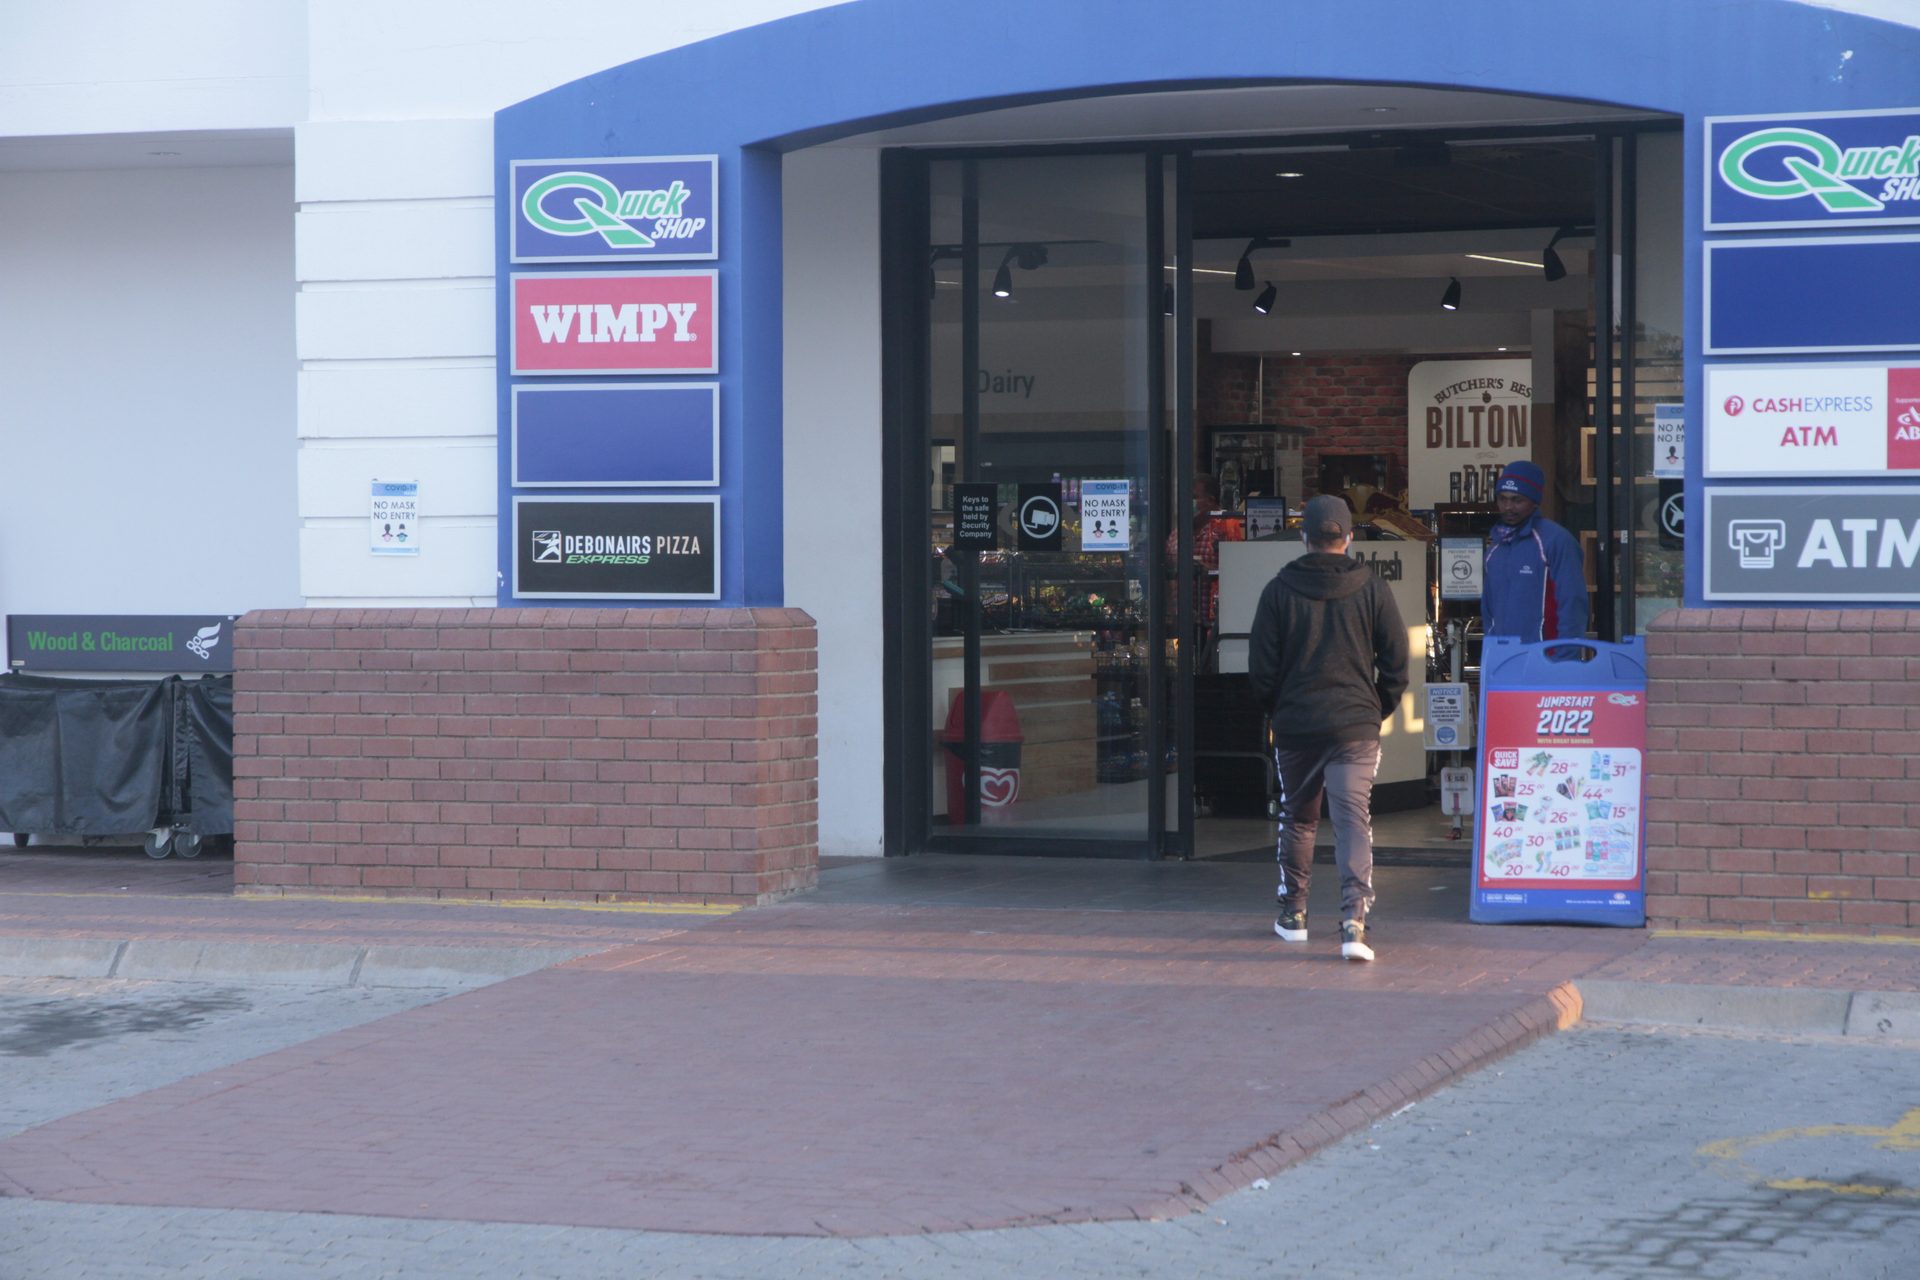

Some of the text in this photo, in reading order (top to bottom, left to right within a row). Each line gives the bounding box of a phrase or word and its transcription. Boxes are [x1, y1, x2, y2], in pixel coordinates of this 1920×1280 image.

[651, 218, 705, 239] SHOP
[530, 303, 696, 343] WIMPY
[977, 370, 1035, 398] Dairy
[1434, 378, 1504, 404] BUTCHER'S
[1752, 397, 1873, 413] CASHEXPRESS
[1426, 405, 1527, 448] BILTON
[1658, 424, 1673, 432] NO
[1657, 434, 1673, 442] NO
[1780, 426, 1838, 446] ATM
[962, 495, 980, 504] Keys
[1085, 499, 1126, 508] NO MASK
[374, 501, 415, 510] NO MASK
[374, 512, 416, 520] NO ENTRY
[963, 512, 989, 521] held by
[1085, 509, 1126, 518] NO ENTRY
[961, 521, 990, 530] Security
[959, 530, 992, 539] Company
[565, 536, 701, 554] DEBONAIRS PIZZA
[1797, 519, 1920, 568] ATM
[566, 555, 650, 564] EXPRESS
[27, 631, 173, 650] Wood & Charcoal
[1537, 696, 1595, 708] JUMPSTART
[1536, 710, 1593, 735] 2022
[1494, 751, 1518, 759] QUICK
[1494, 759, 1517, 767] SAVE
